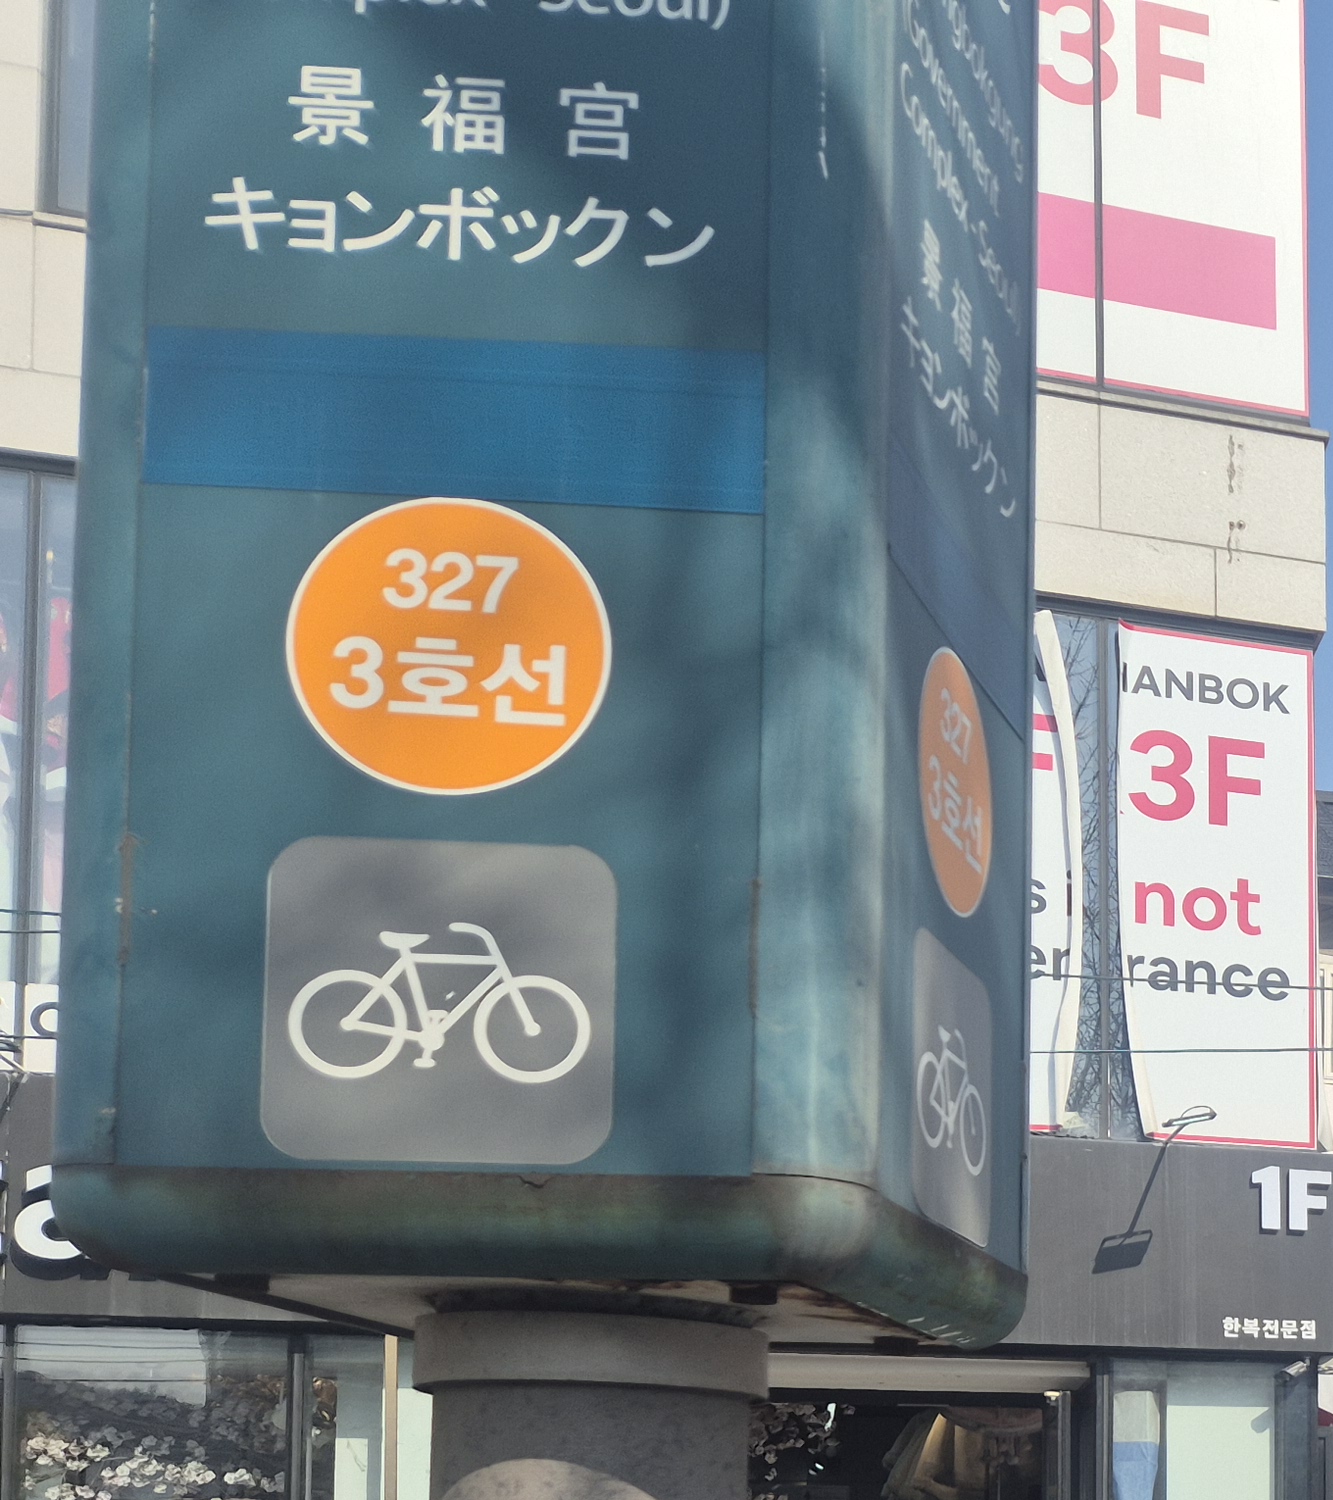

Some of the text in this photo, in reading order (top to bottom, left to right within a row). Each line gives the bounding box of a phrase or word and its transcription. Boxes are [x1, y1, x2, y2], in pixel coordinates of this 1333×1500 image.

[1037, 0, 1209, 119] 3F
[204, 176, 716, 268] キョンボックン
[382, 547, 520, 614] 327
[328, 635, 568, 728] 3호선
[940, 687, 972, 767] 327
[1127, 728, 1266, 828] 3F
[1133, 877, 1263, 937] not
[1251, 1165, 1333, 1232] 1F
[1221, 1316, 1318, 1341] 한복전문점
